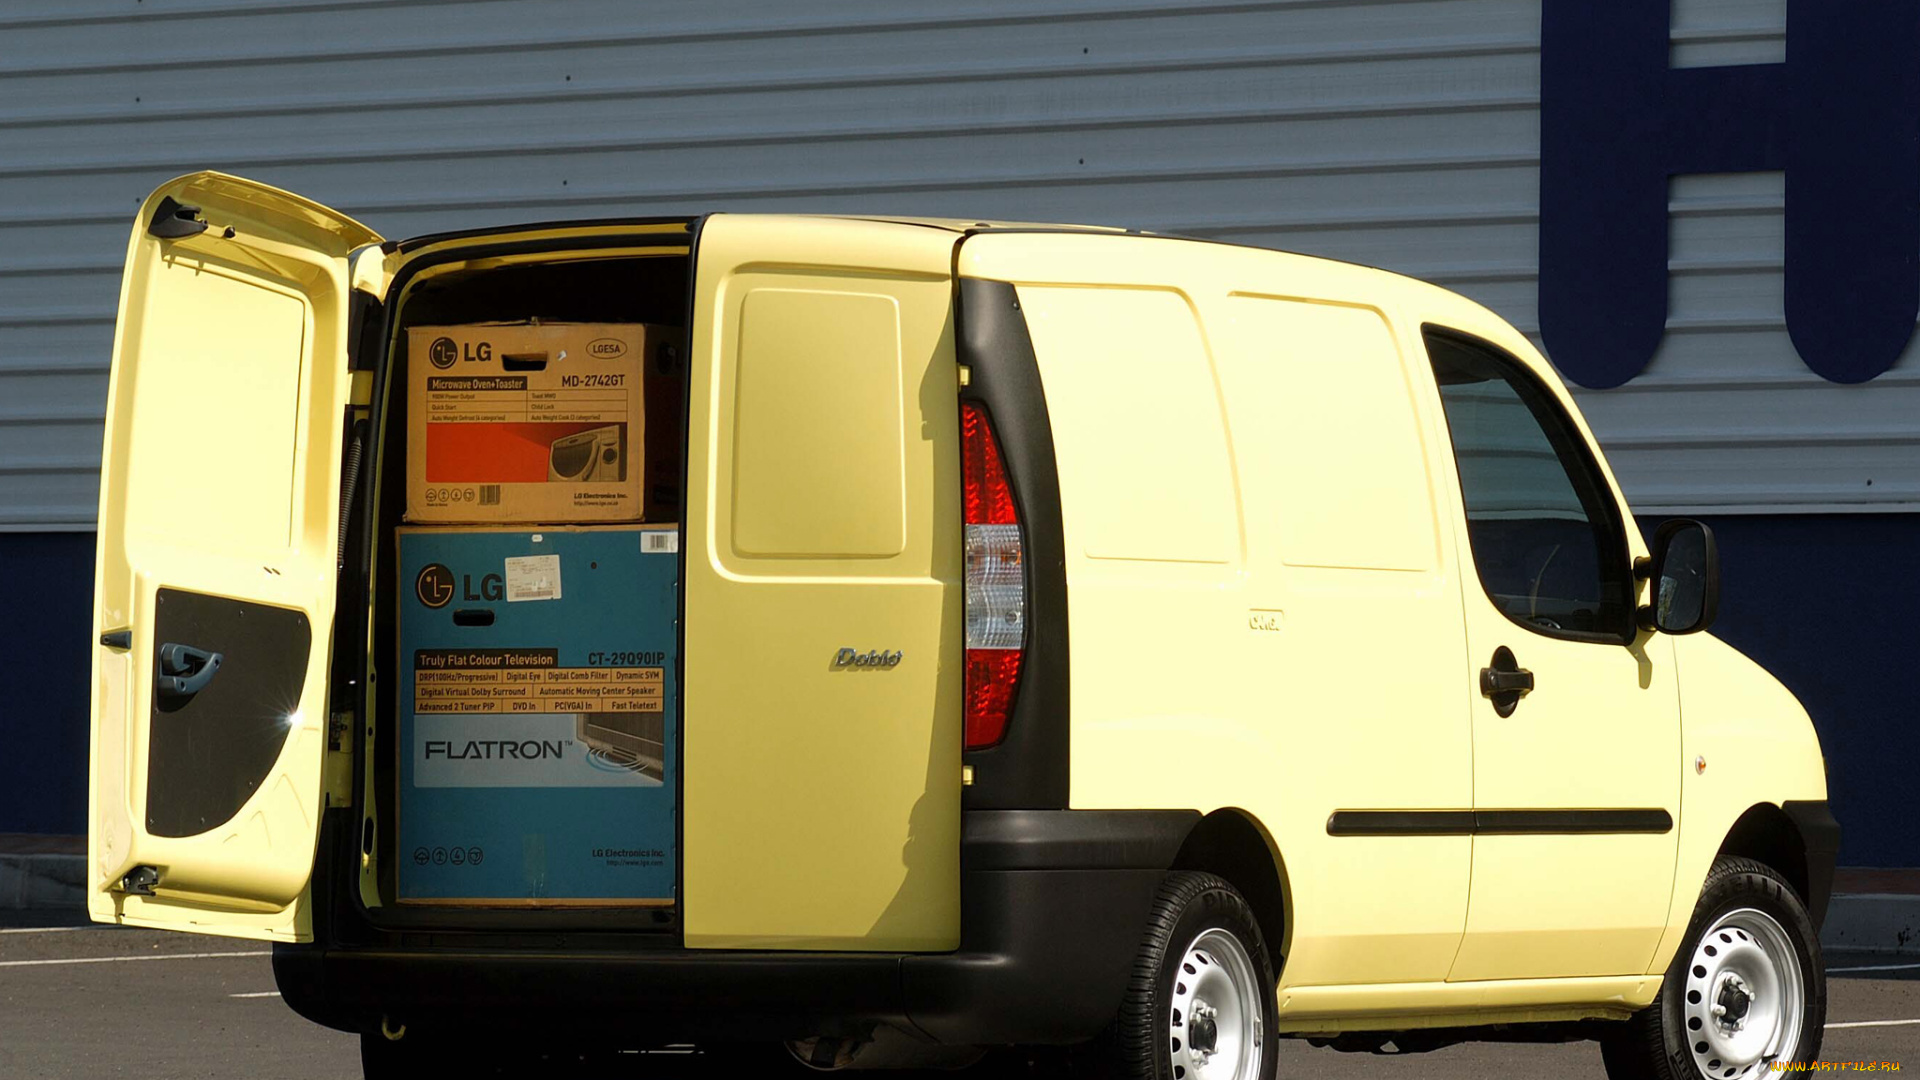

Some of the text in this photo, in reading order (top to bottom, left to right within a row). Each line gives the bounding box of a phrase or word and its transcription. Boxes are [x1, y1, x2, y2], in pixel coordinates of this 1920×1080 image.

[464, 342, 492, 362] LG
[592, 344, 620, 354] LGESA
[432, 378, 523, 390] Microwave Oven+Toaster
[562, 374, 625, 387] MD-2742GT
[463, 573, 504, 601] LG
[420, 654, 553, 668] Truly Flat Colour Television
[506, 672, 541, 682] Digital Eye
[548, 671, 609, 682] Digital Comb Filter
[616, 671, 660, 681] Dynamic SVM
[420, 686, 526, 697] Digital Virtual Dolby Surround
[539, 686, 656, 697] Automatic Moving Center Speaker
[418, 702, 495, 711] Advanced 2 Tuner PIP
[512, 702, 536, 711] DVD In
[585, 701, 593, 710] In
[611, 701, 657, 710] Fast Teletext
[592, 849, 665, 857] LG Electronics Inc.
